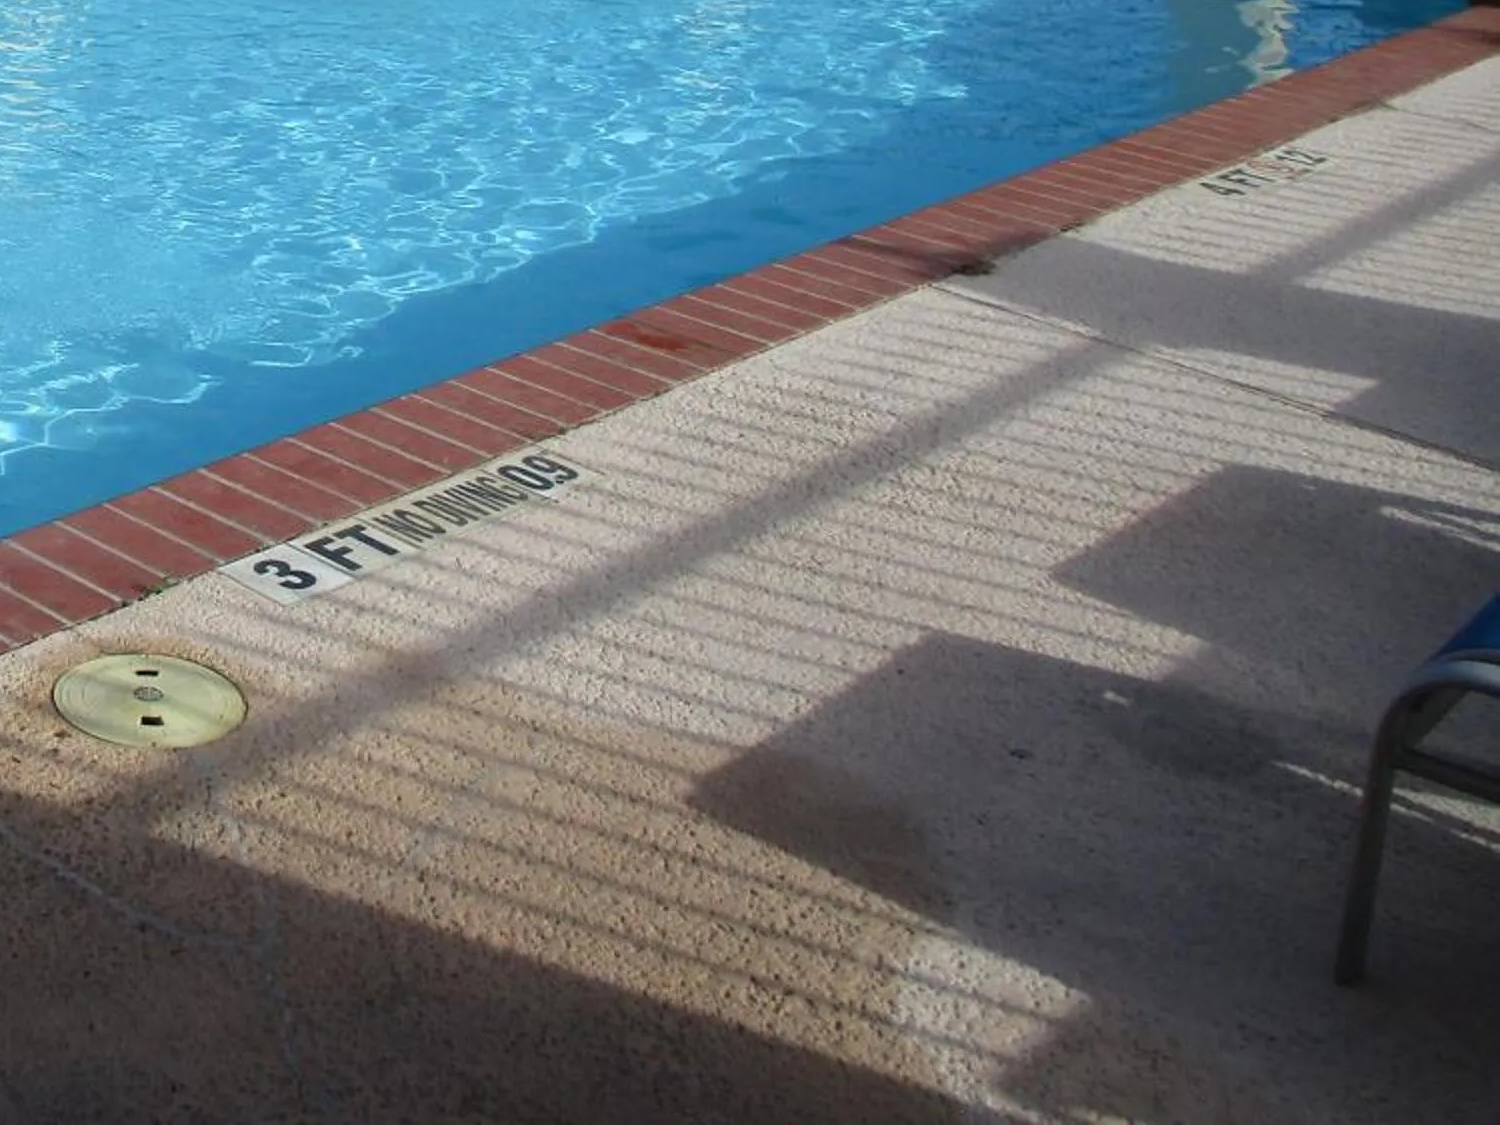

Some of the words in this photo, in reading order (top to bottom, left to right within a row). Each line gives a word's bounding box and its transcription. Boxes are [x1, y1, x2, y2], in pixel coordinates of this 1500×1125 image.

[1200, 181, 1247, 196] 4
[1216, 168, 1277, 189] FT
[253, 559, 318, 590] 3
[304, 525, 400, 572] FT
[371, 508, 447, 544] NO
[411, 475, 529, 527] DIVING
[497, 454, 579, 491] 09
